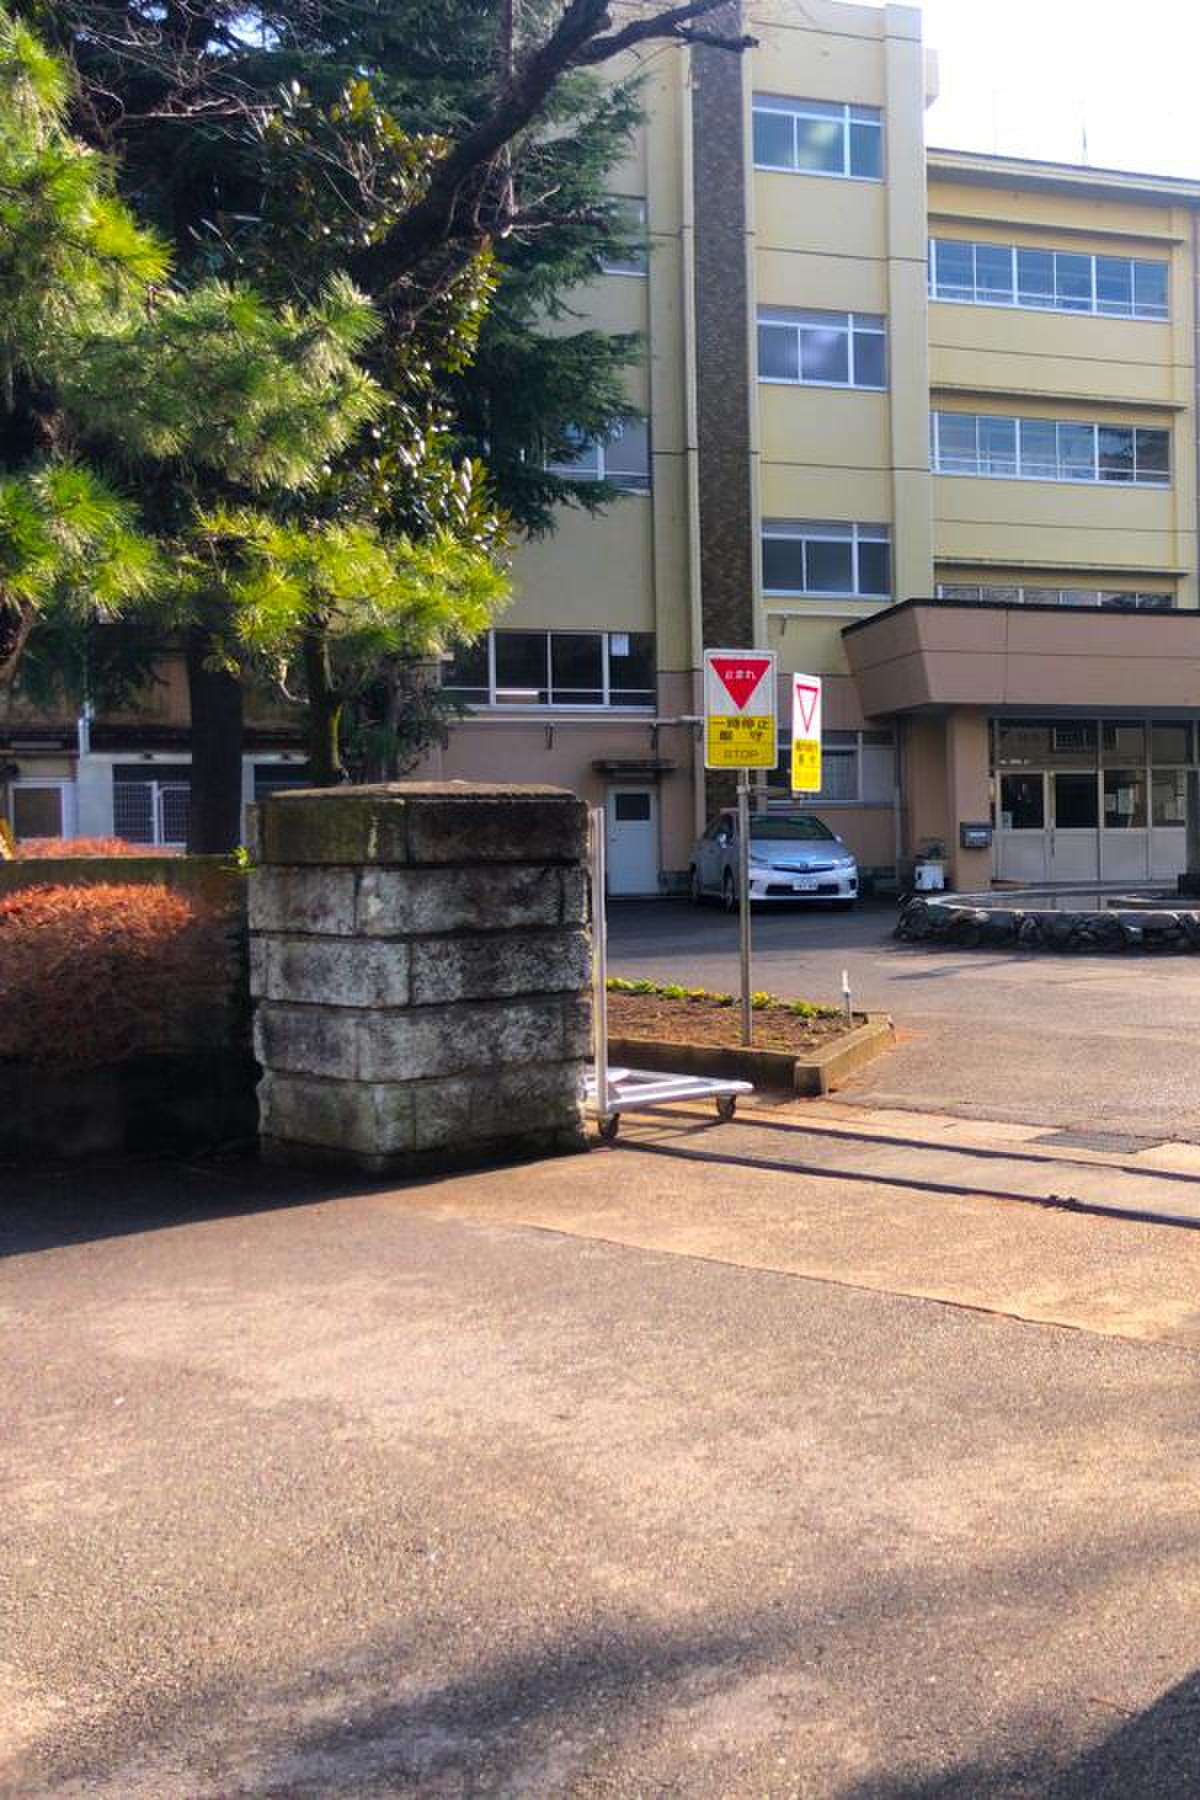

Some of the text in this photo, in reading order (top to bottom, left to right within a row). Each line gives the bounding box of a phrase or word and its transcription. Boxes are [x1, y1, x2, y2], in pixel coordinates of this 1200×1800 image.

[711, 717, 769, 730] 一時停止
[723, 749, 759, 759] STOP
